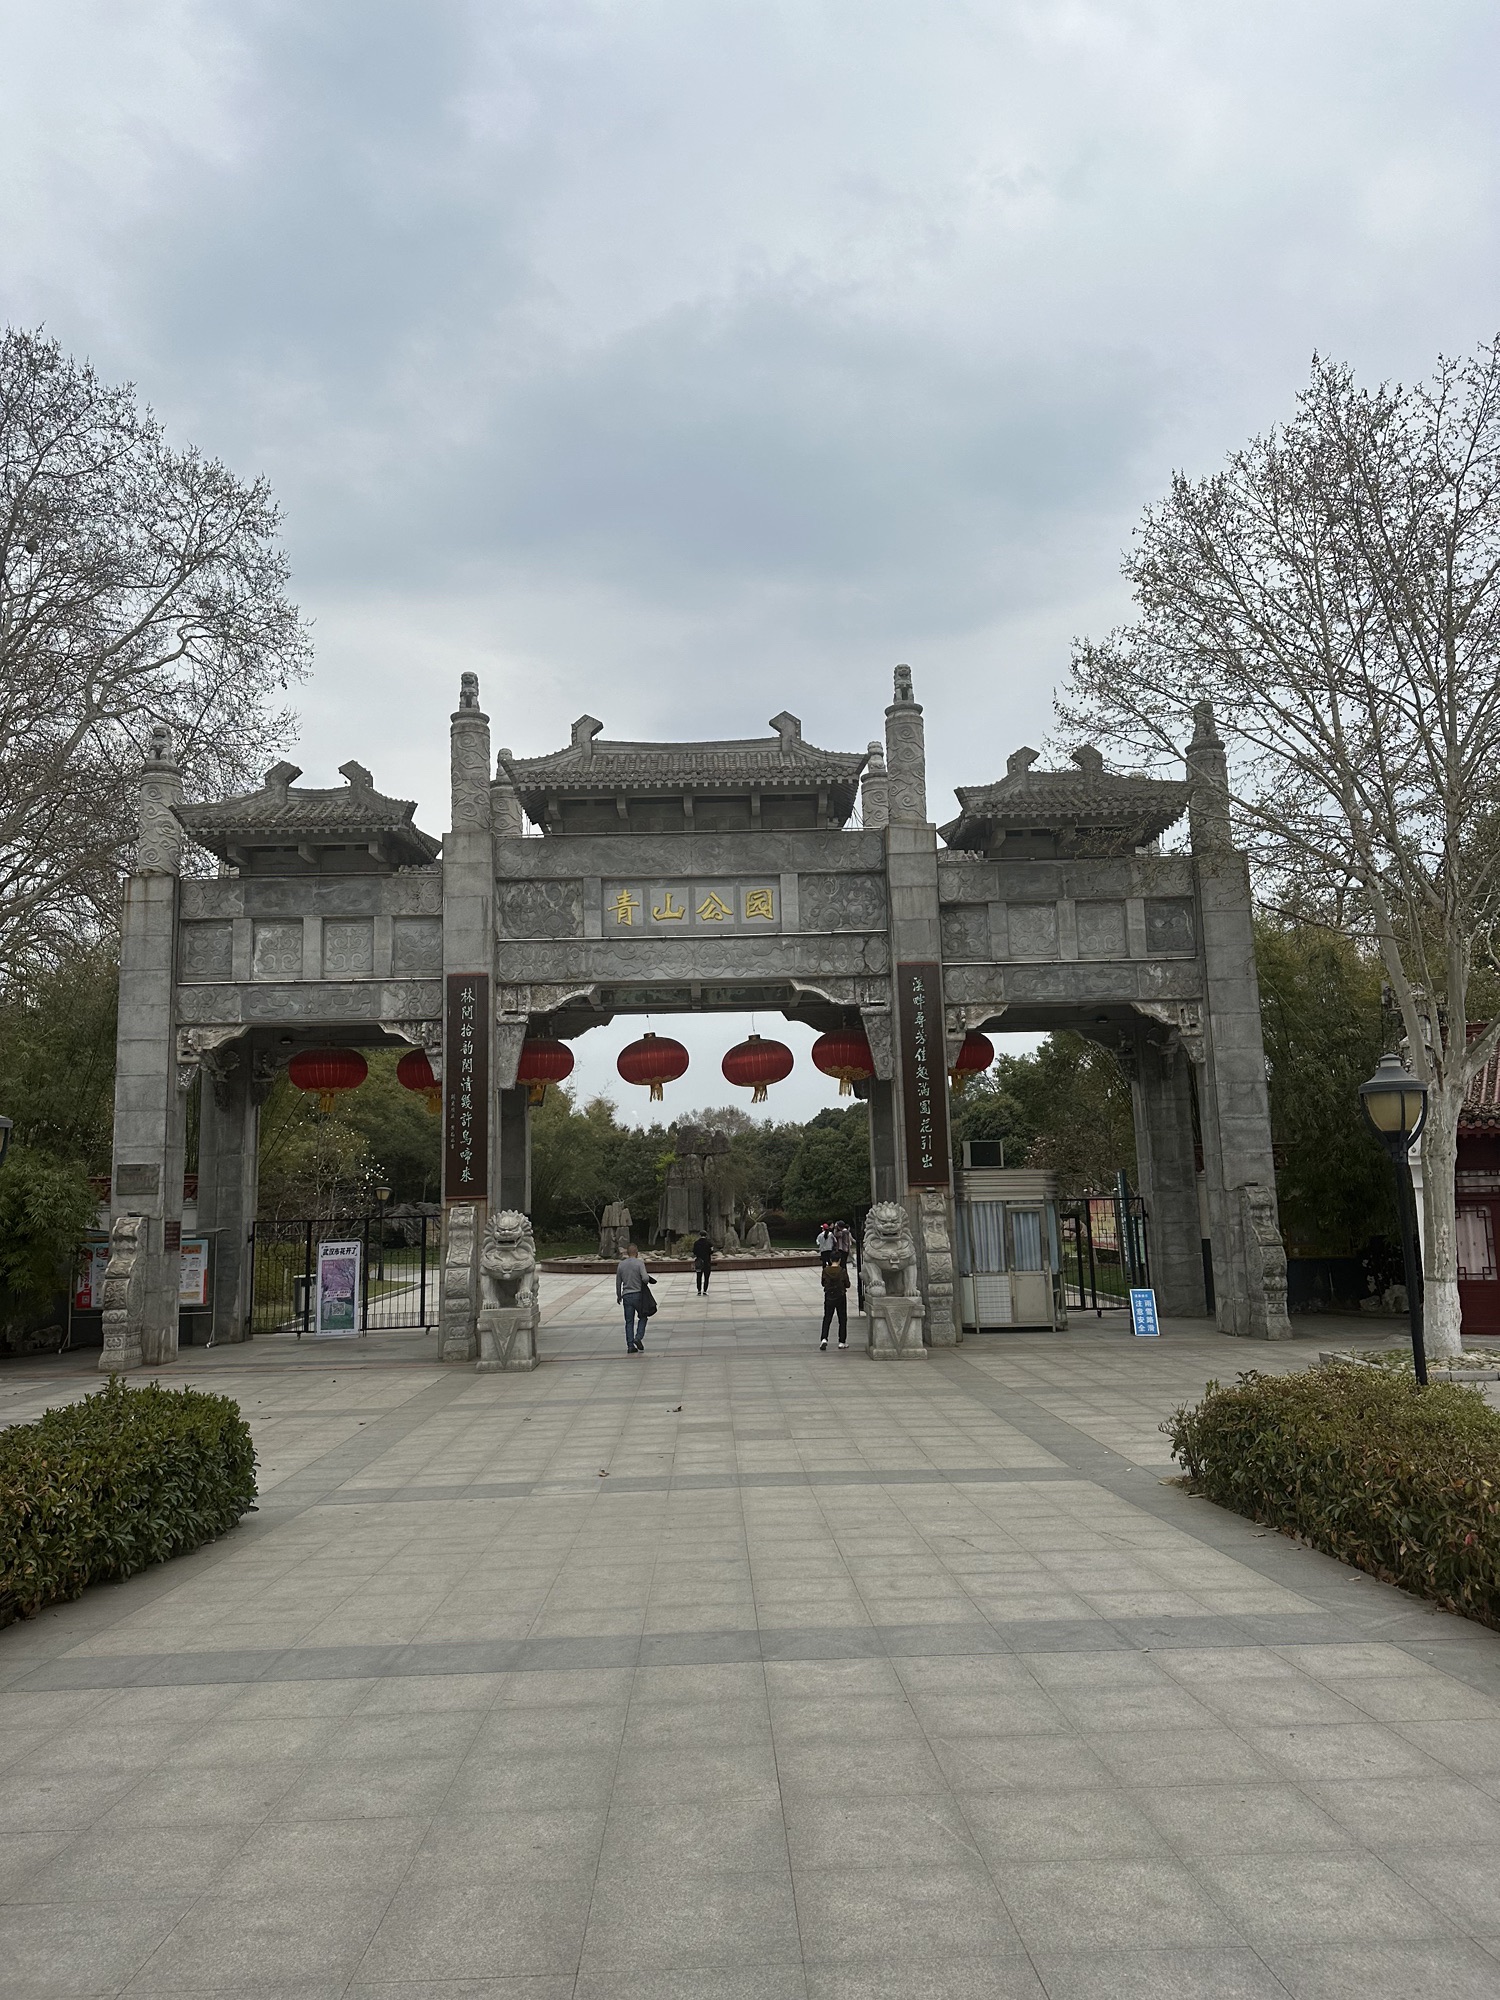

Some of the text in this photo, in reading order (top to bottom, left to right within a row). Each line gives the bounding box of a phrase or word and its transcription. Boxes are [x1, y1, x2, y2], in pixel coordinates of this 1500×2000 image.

[607, 888, 774, 926] 青山公园
[1135, 1299, 1146, 1332] 注意安全
